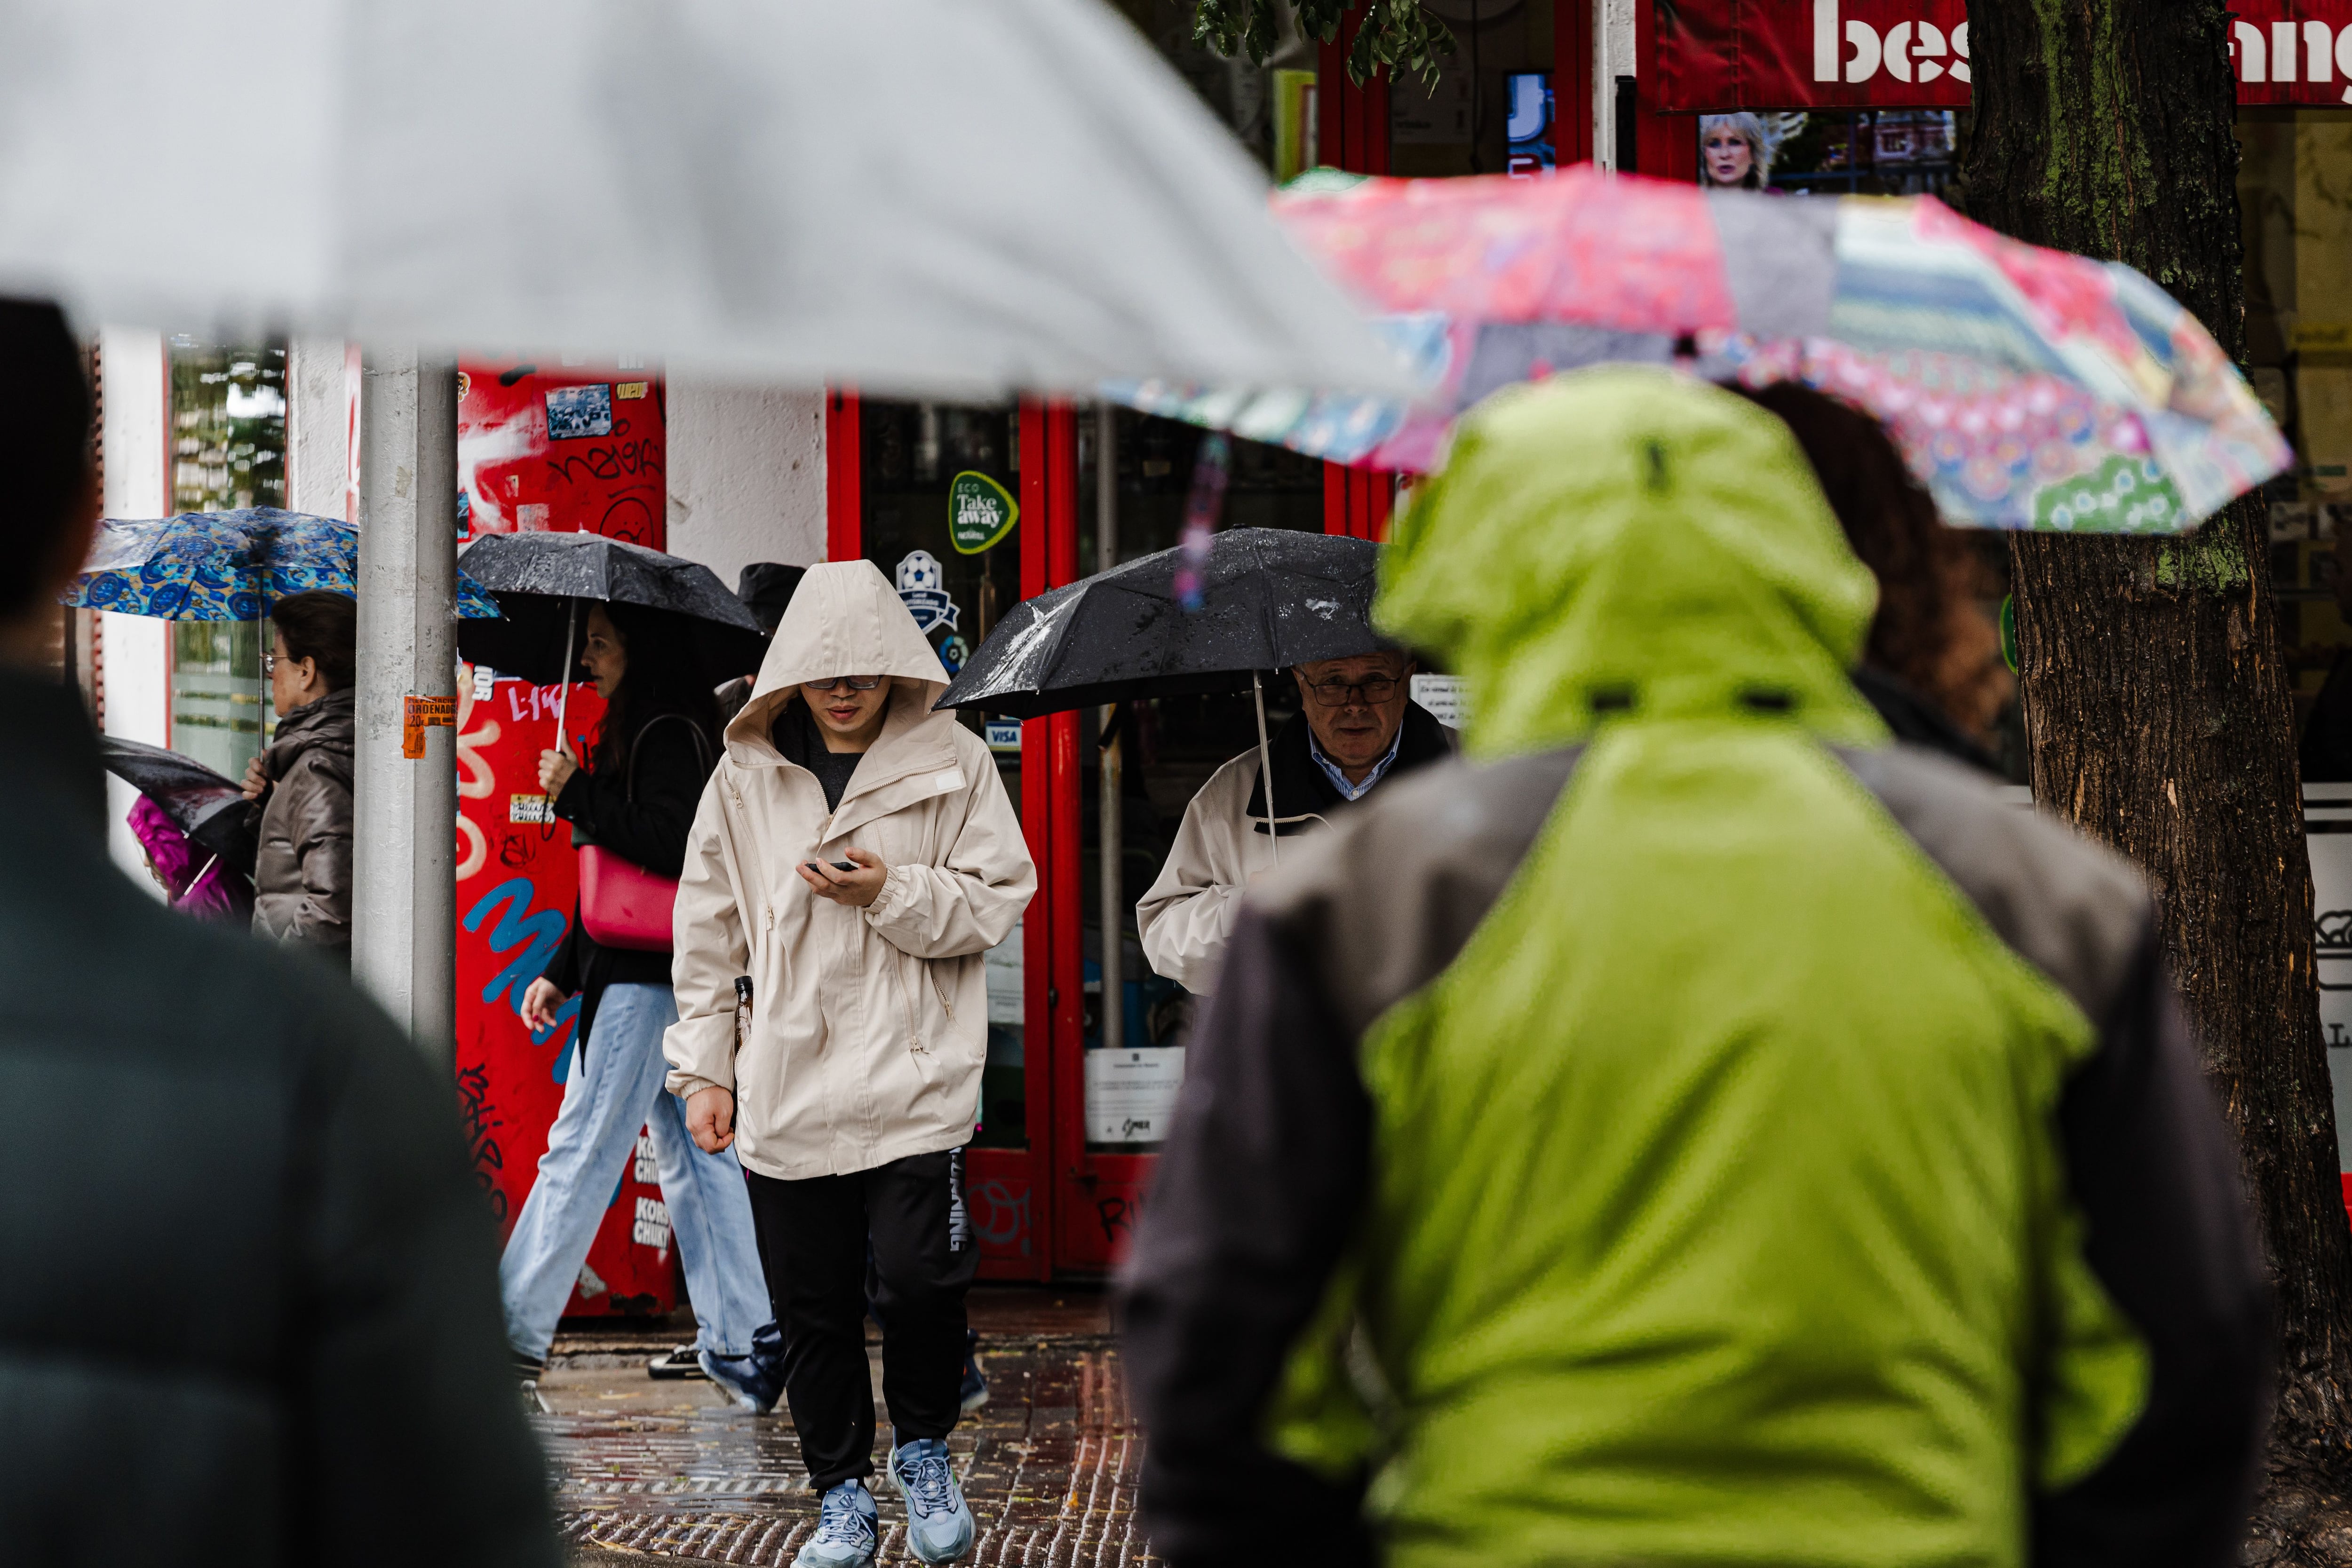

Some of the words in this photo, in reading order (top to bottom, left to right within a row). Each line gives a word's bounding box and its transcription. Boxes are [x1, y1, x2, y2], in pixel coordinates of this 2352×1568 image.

[958, 483, 979, 493] ECO
[957, 494, 997, 511] Take
[957, 509, 1002, 528] away
[992, 730, 1017, 742] VISA
[636, 1136, 656, 1159] KO
[634, 1159, 659, 1185] CHU
